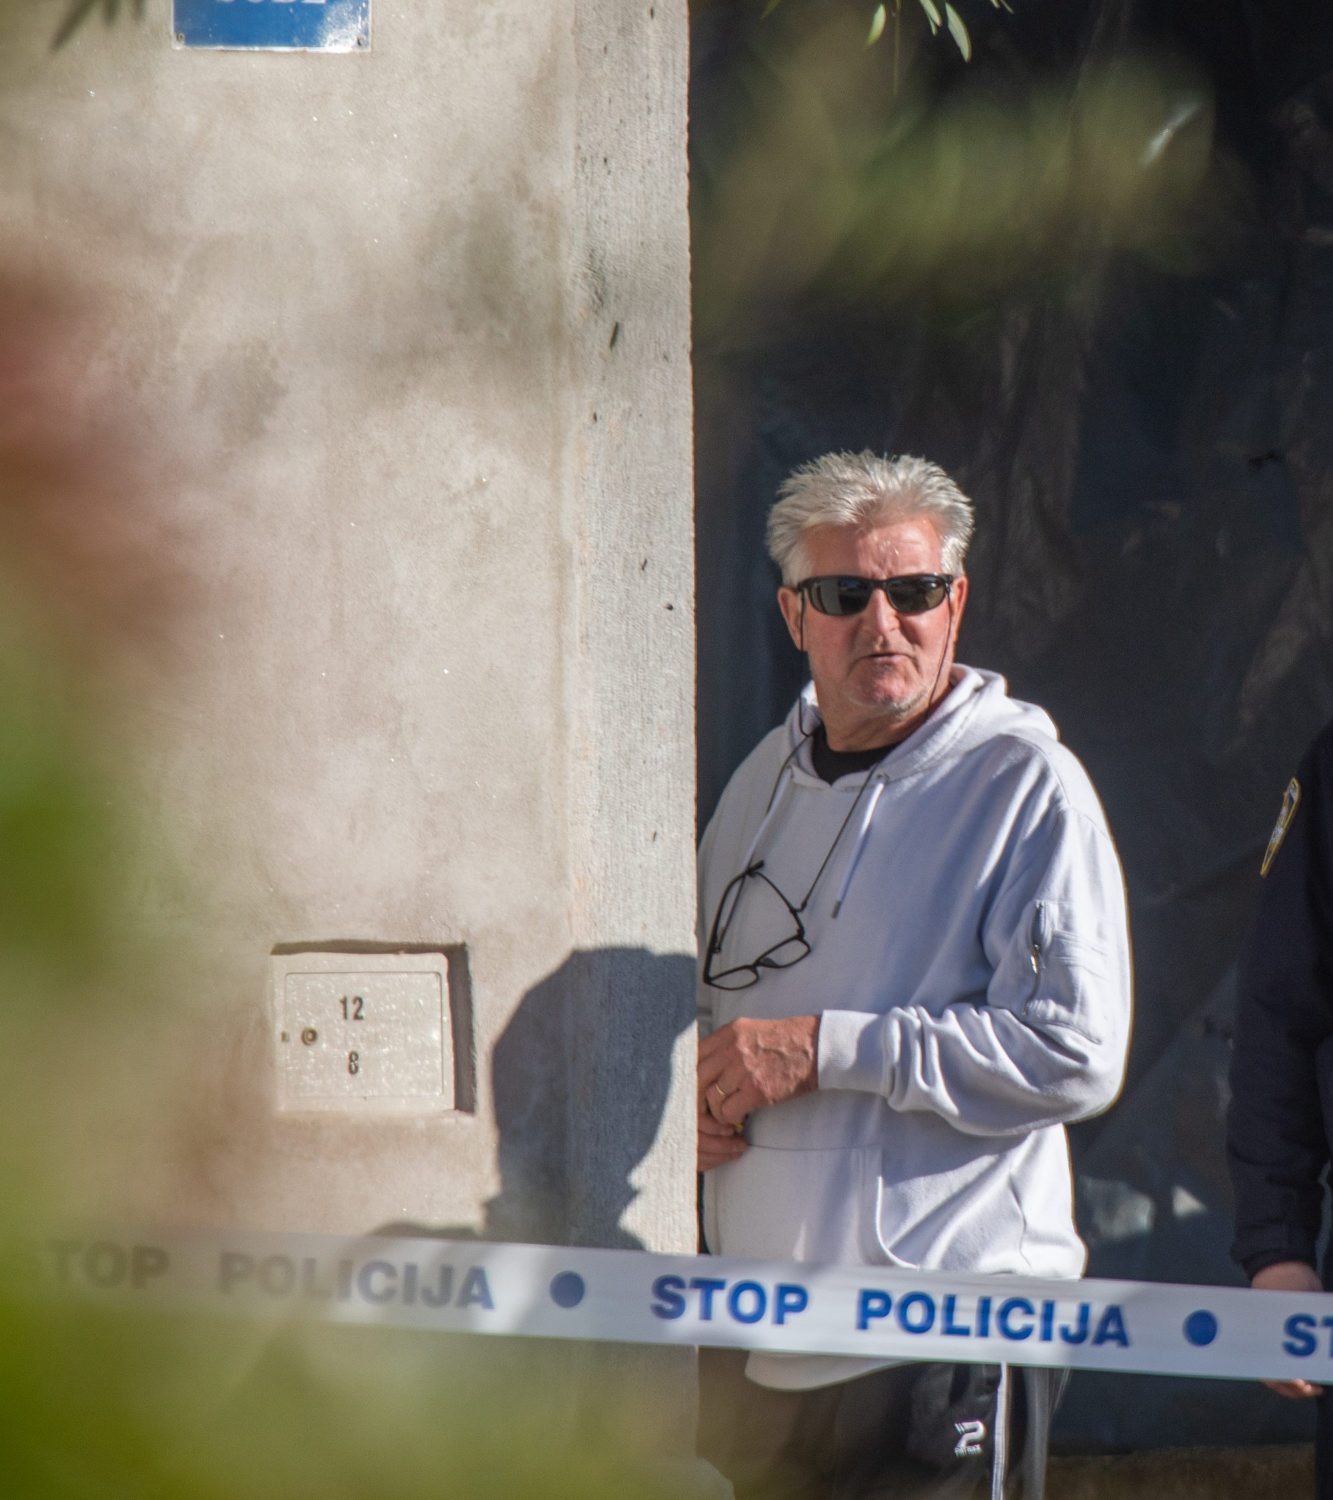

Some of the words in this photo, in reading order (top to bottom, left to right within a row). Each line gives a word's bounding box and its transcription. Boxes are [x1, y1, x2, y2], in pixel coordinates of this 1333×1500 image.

[339, 996, 365, 1021] 12
[18, 1236, 170, 1291] TOP
[216, 1251, 496, 1311] POLICIJA
[650, 1273, 809, 1326] STOP
[855, 1288, 1130, 1348] POLICIJA
